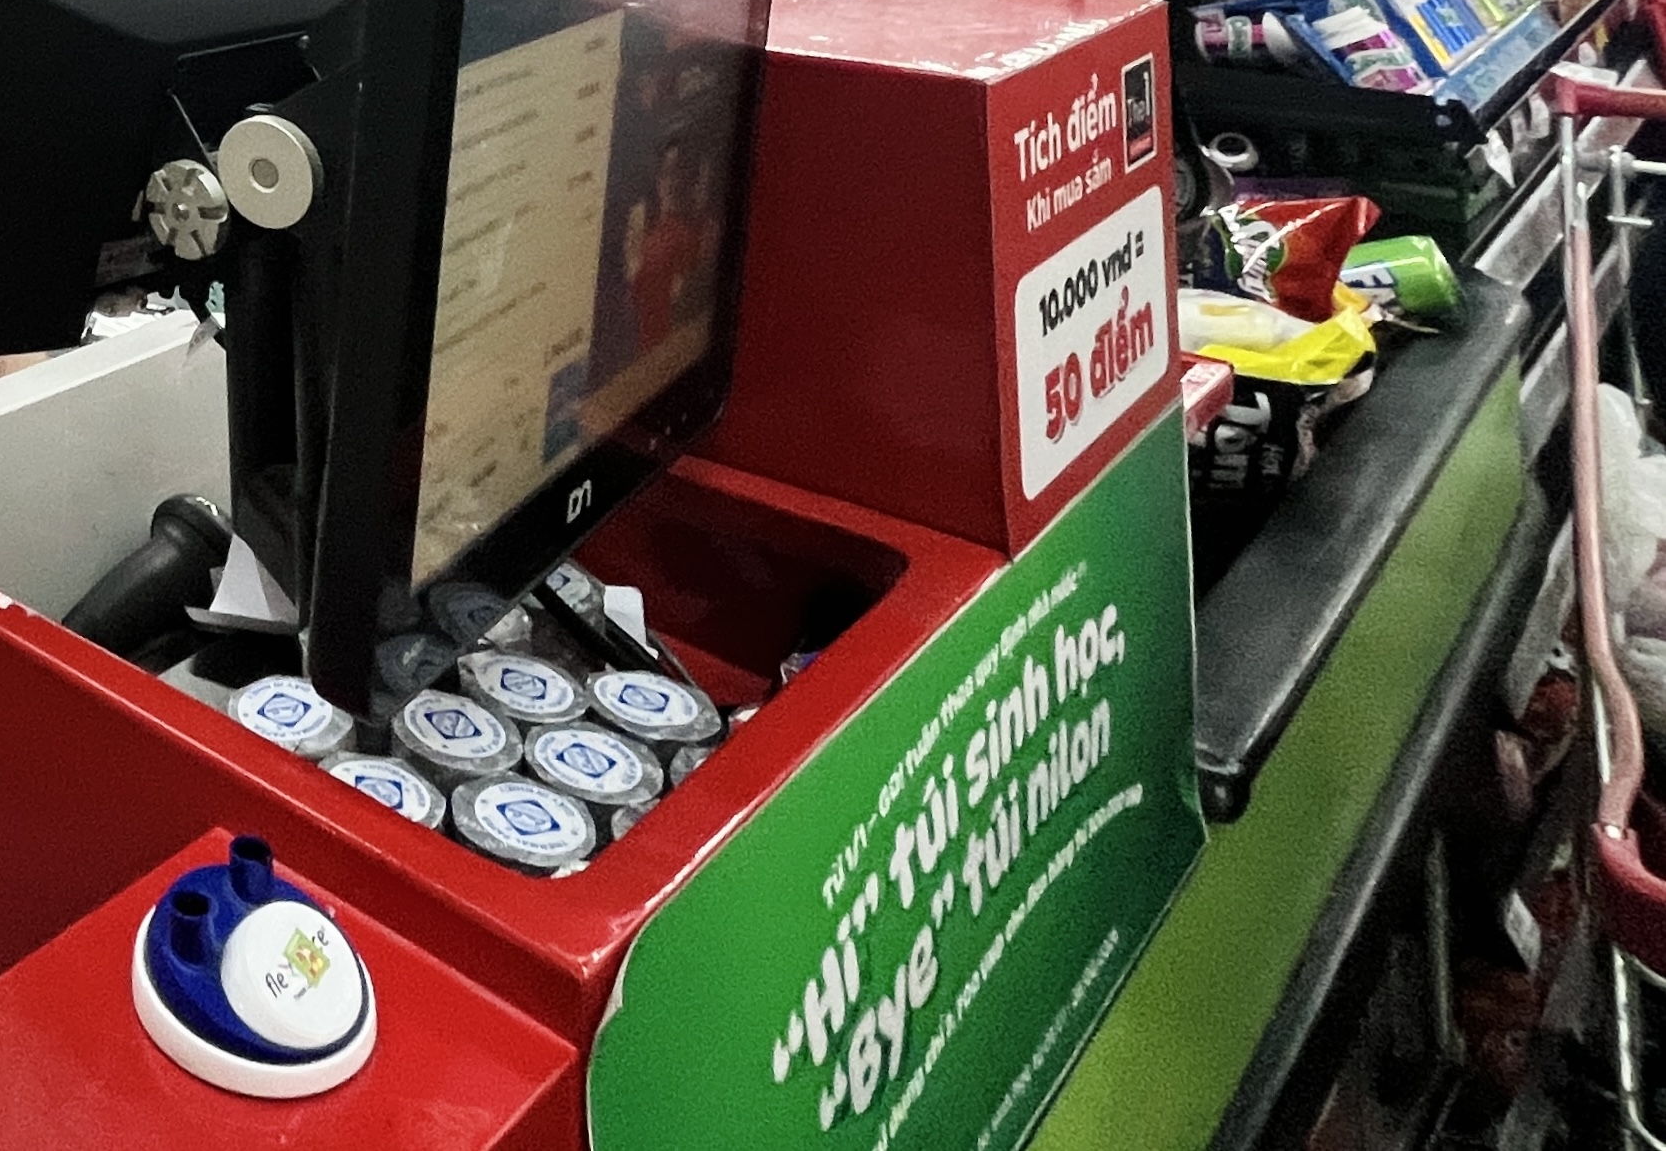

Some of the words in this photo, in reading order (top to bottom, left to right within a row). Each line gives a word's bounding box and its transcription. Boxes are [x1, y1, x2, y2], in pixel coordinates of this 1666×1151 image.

[1013, 111, 1062, 183] Tích
[1066, 71, 1117, 153] điểm
[1026, 186, 1051, 234] Khi
[1053, 175, 1084, 216] mua
[1084, 147, 1113, 195] sắm
[1038, 258, 1099, 338] 10.000
[1100, 230, 1132, 289] vnd
[1044, 351, 1083, 444] 50
[1089, 284, 1155, 400] điểm
[889, 752, 961, 910] túi
[964, 654, 1050, 807] sinh
[1054, 603, 1126, 705] học,
[962, 777, 1022, 918] túi
[1027, 697, 1112, 837] nilon
